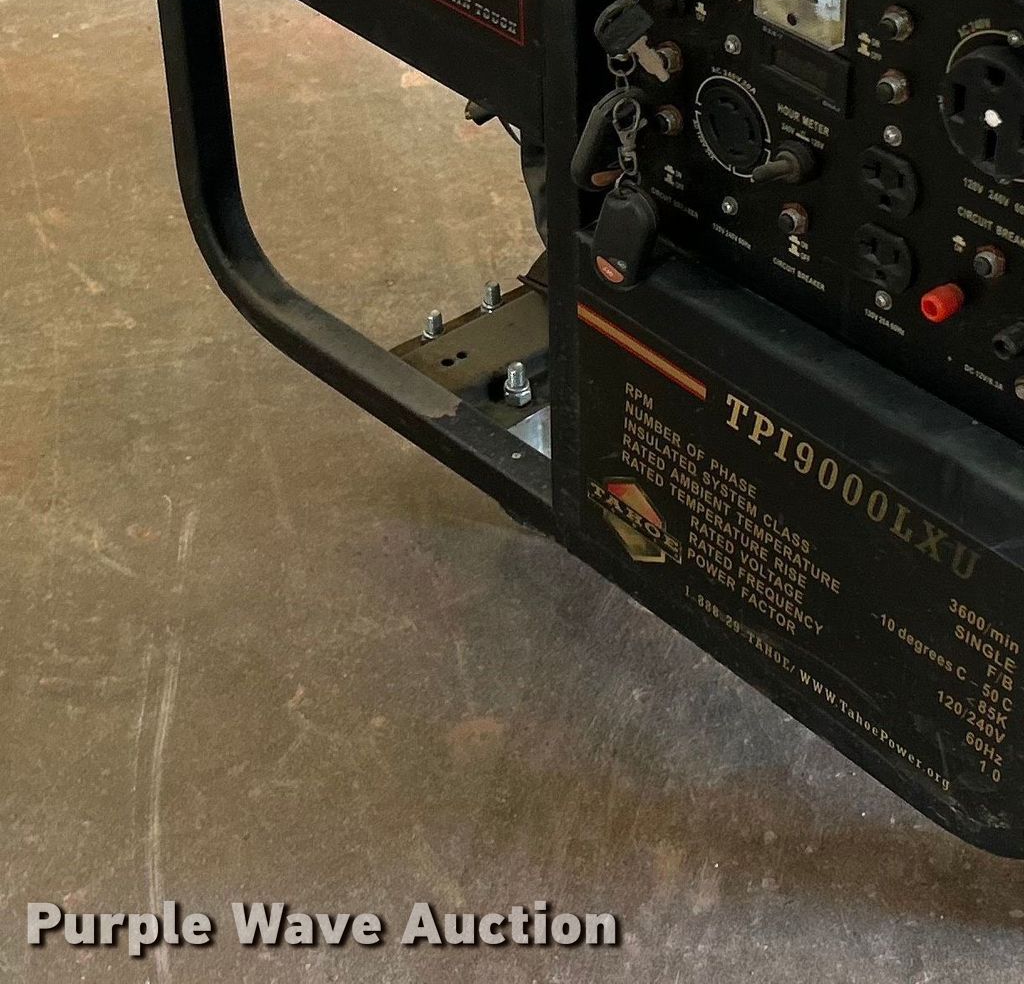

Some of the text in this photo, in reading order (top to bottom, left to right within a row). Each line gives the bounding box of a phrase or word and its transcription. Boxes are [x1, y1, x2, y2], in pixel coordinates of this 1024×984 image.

[801, 114, 830, 137] METER
[957, 206, 993, 232] CIRCUIT
[625, 382, 653, 410] RPM
[624, 417, 810, 554] INSULATED SYSTEM CLASS
[625, 400, 757, 500] NUMBER OF PHASE
[725, 393, 981, 580] TPI9000LXU
[591, 482, 679, 553] TAHOE
[622, 450, 807, 589] RATED TEMPERATURE RISE
[623, 433, 841, 594] RATED AMBIENT TEMPERATURE
[687, 547, 796, 636] POWER FACTOR
[689, 531, 823, 636] RATED FREQUENCY
[690, 515, 803, 604] RATED VOLTAGE
[949, 598, 1020, 655] 3600/min
[954, 624, 1016, 674] SINGLE
[898, 627, 1013, 712] degrees C 50 C
[987, 664, 1014, 692] F/B
[799, 668, 951, 791] WWW.TahoePower.org
[937, 690, 1006, 744] 120/240V
[965, 731, 1002, 766] 60Hz
